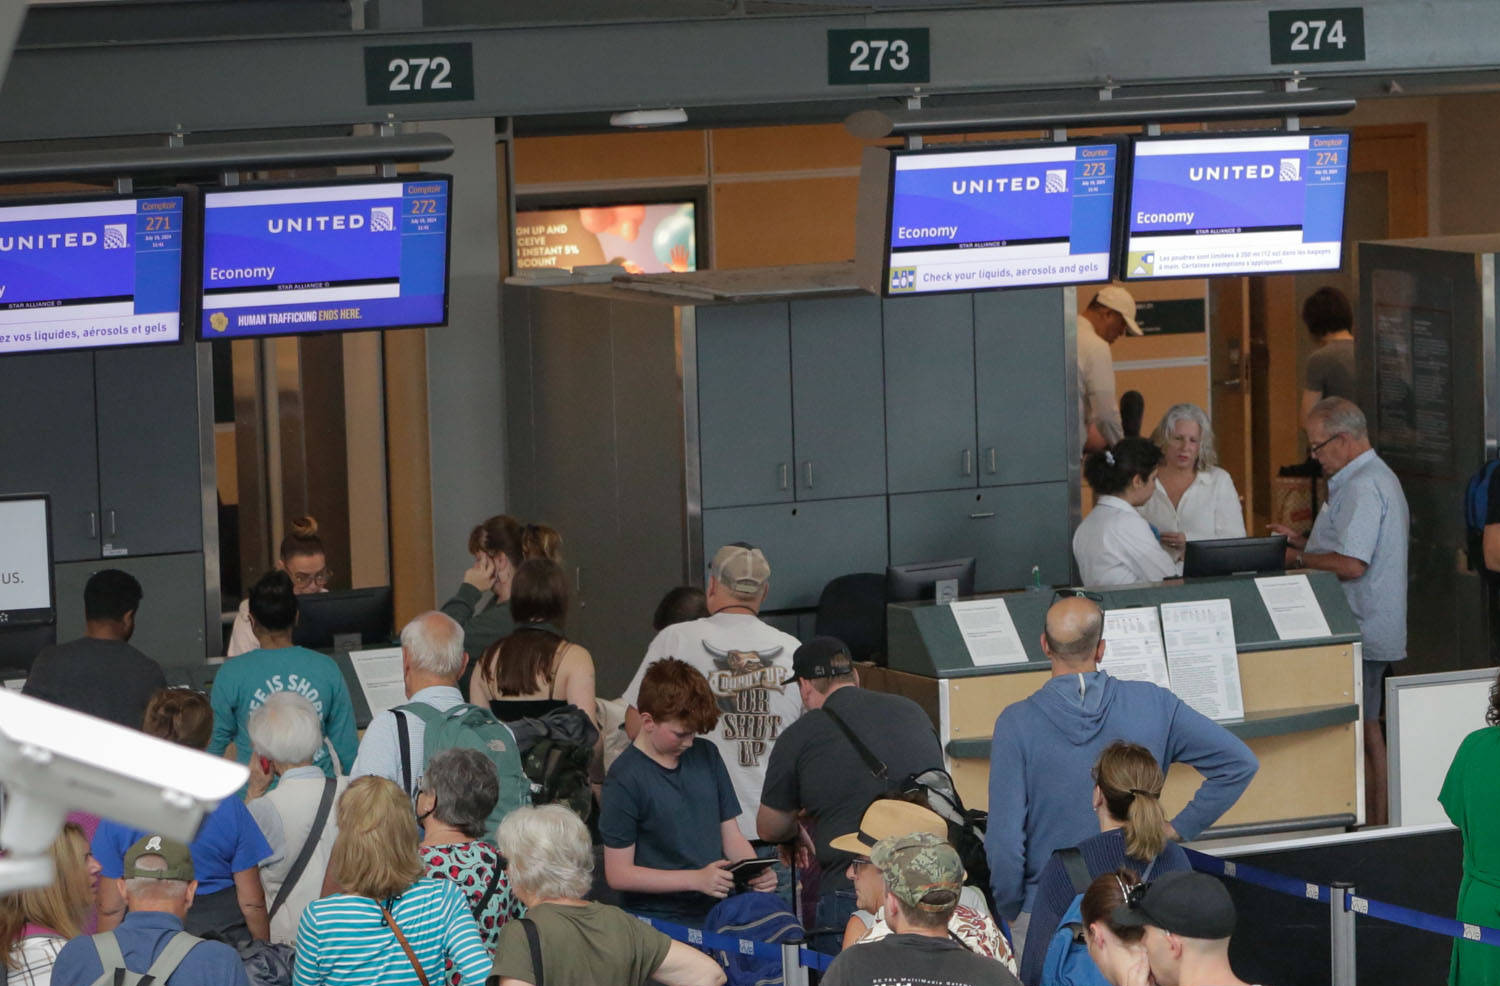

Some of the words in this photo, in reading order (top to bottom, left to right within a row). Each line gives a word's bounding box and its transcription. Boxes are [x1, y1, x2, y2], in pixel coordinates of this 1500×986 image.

[1290, 19, 1347, 52] 274
[849, 39, 911, 73] 273
[388, 56, 453, 92] 272
[1314, 138, 1343, 147] Comptoir
[1082, 149, 1109, 158] Counter
[1316, 152, 1338, 165] 274
[1083, 163, 1106, 176] 273
[1189, 164, 1275, 182] UNITED
[408, 185, 441, 195] Comptoir
[952, 177, 1040, 195] UNITED
[142, 202, 176, 211] Comptoir
[412, 200, 437, 214] 272
[146, 216, 170, 230] 271
[268, 214, 365, 234] UNITED
[1137, 211, 1195, 225] Economy
[532, 225, 546, 235] UP
[546, 224, 568, 234] AND
[898, 226, 958, 240] Economy
[0, 231, 97, 251] UNITED
[210, 266, 276, 281] Economy
[923, 271, 952, 282] Check
[954, 271, 976, 282] your
[979, 267, 1014, 280] liquids,
[1016, 265, 1057, 277] aerosols
[1059, 263, 1076, 274] and
[1078, 262, 1098, 274] gels
[238, 313, 268, 327] HUMAN
[268, 311, 317, 325] TRAFFICKING
[318, 309, 339, 322] ENDS
[340, 308, 363, 320] HERE.
[0, 334, 11, 343] ez
[34, 329, 80, 341] liquides,
[82, 325, 129, 337] aérosols
[131, 324, 142, 334] et
[144, 322, 167, 334] gels
[266, 675, 284, 694] IS
[737, 689, 769, 713] OR
[724, 714, 782, 740] SHUT
[739, 741, 766, 766] UP
